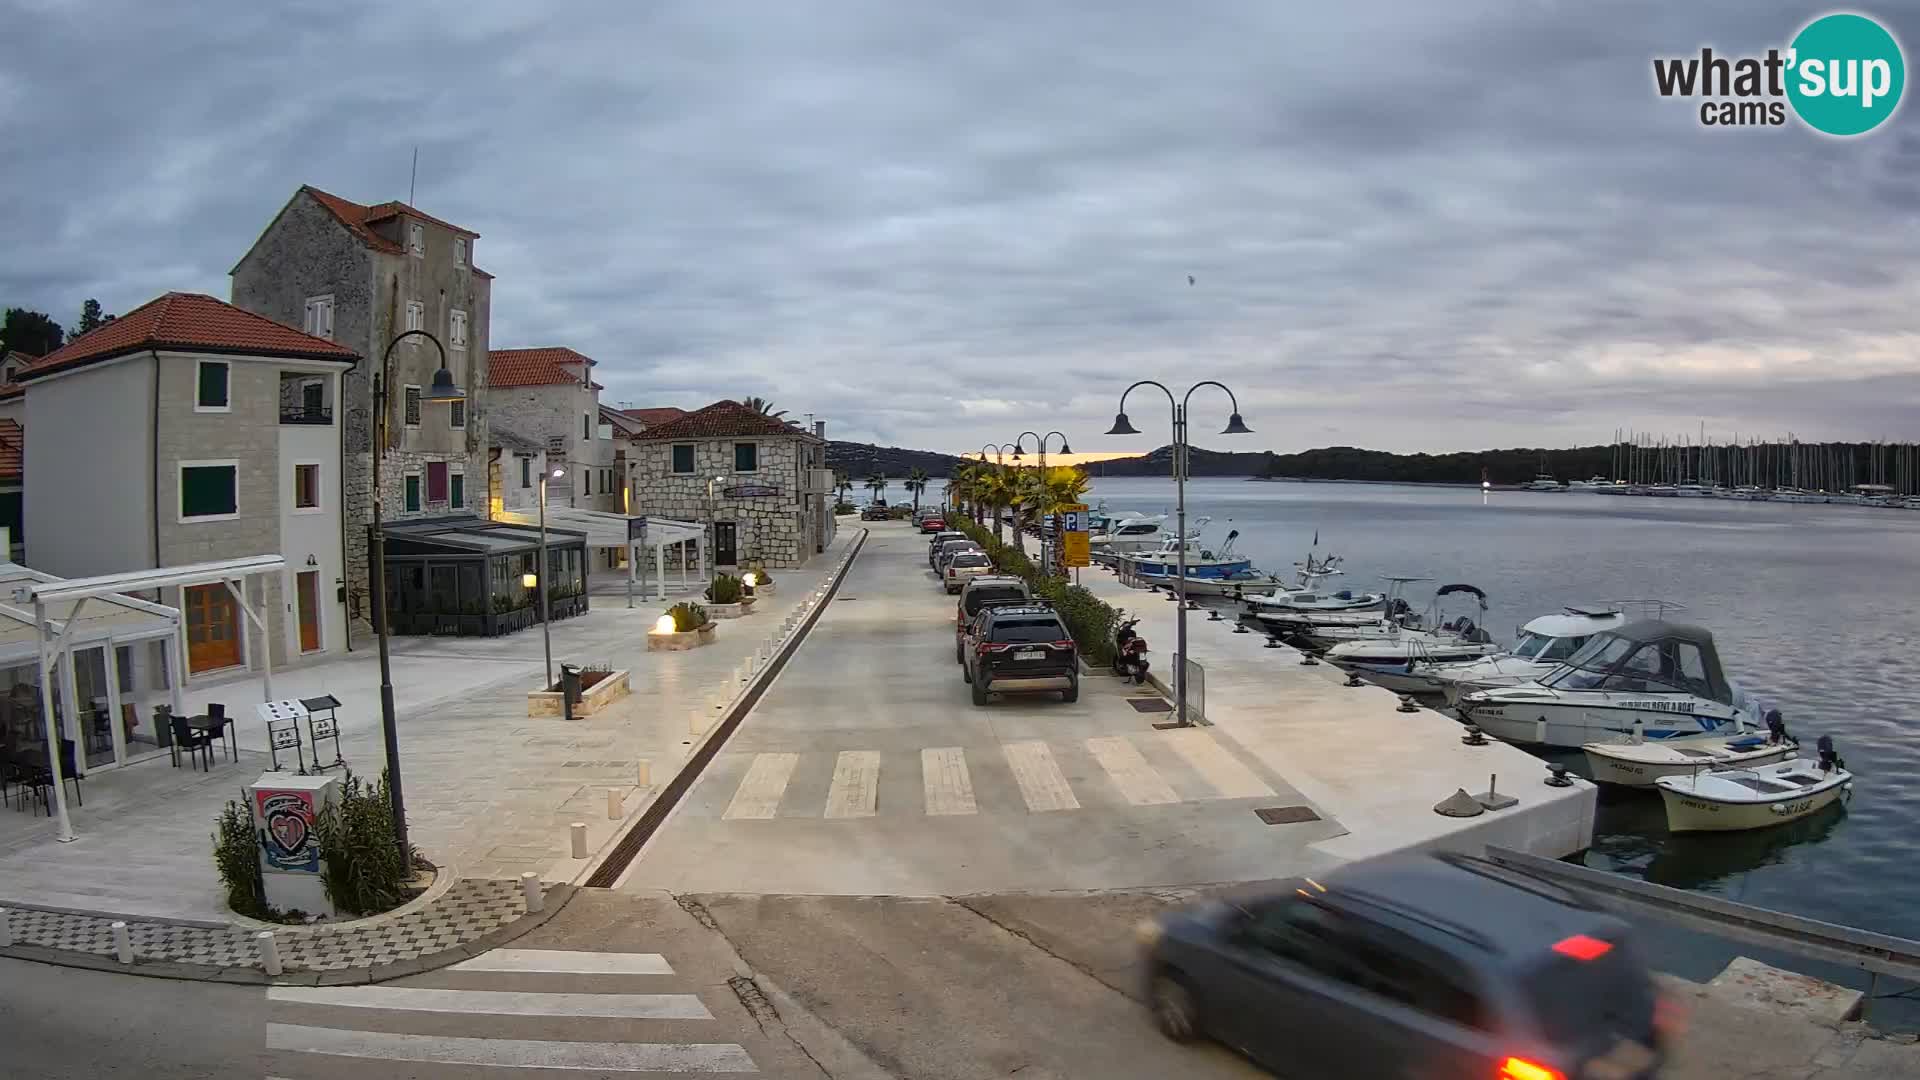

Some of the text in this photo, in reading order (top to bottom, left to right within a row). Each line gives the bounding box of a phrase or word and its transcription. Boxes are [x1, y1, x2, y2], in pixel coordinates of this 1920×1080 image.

[1066, 513, 1077, 530] P
[1651, 701, 1670, 711] RENT
[1677, 702, 1697, 713] BOAT
